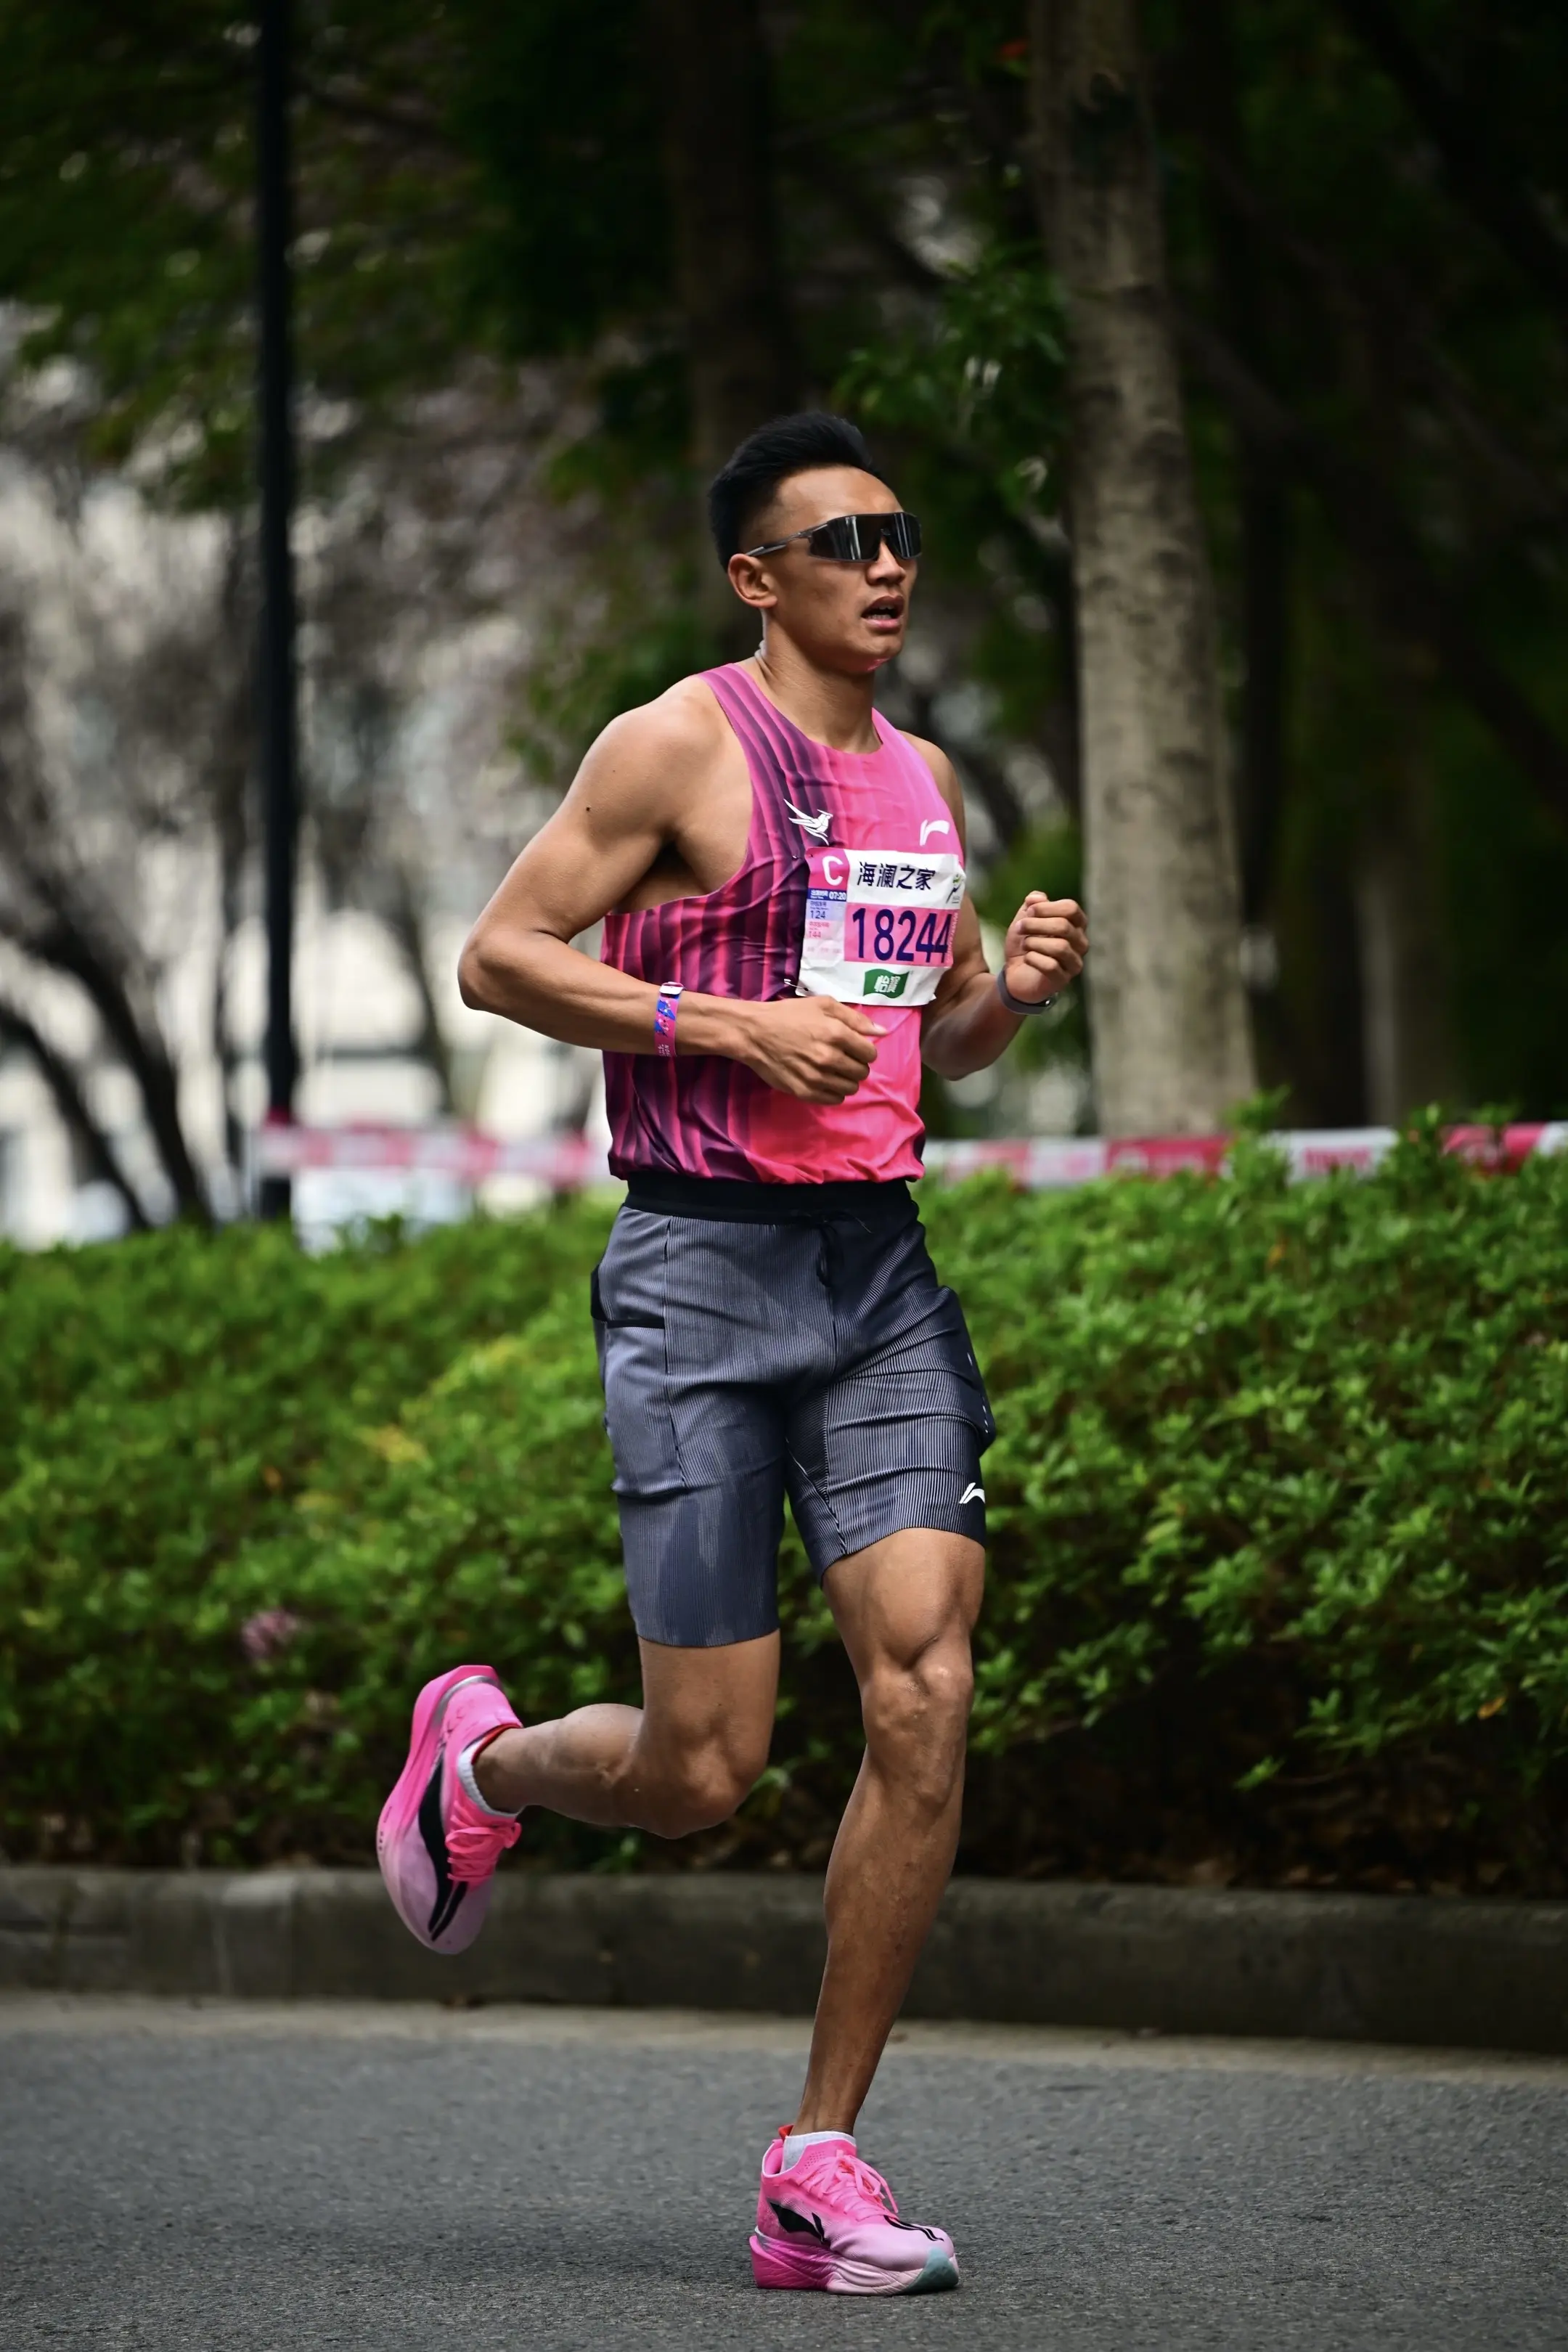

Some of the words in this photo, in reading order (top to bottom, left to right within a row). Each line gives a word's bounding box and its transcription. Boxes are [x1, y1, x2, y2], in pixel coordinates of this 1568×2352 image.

[822, 856, 844, 886] C
[857, 862, 936, 891] 海澜之家
[828, 891, 846, 900] 07:20
[810, 910, 826, 919] 124
[852, 907, 952, 963] 18244
